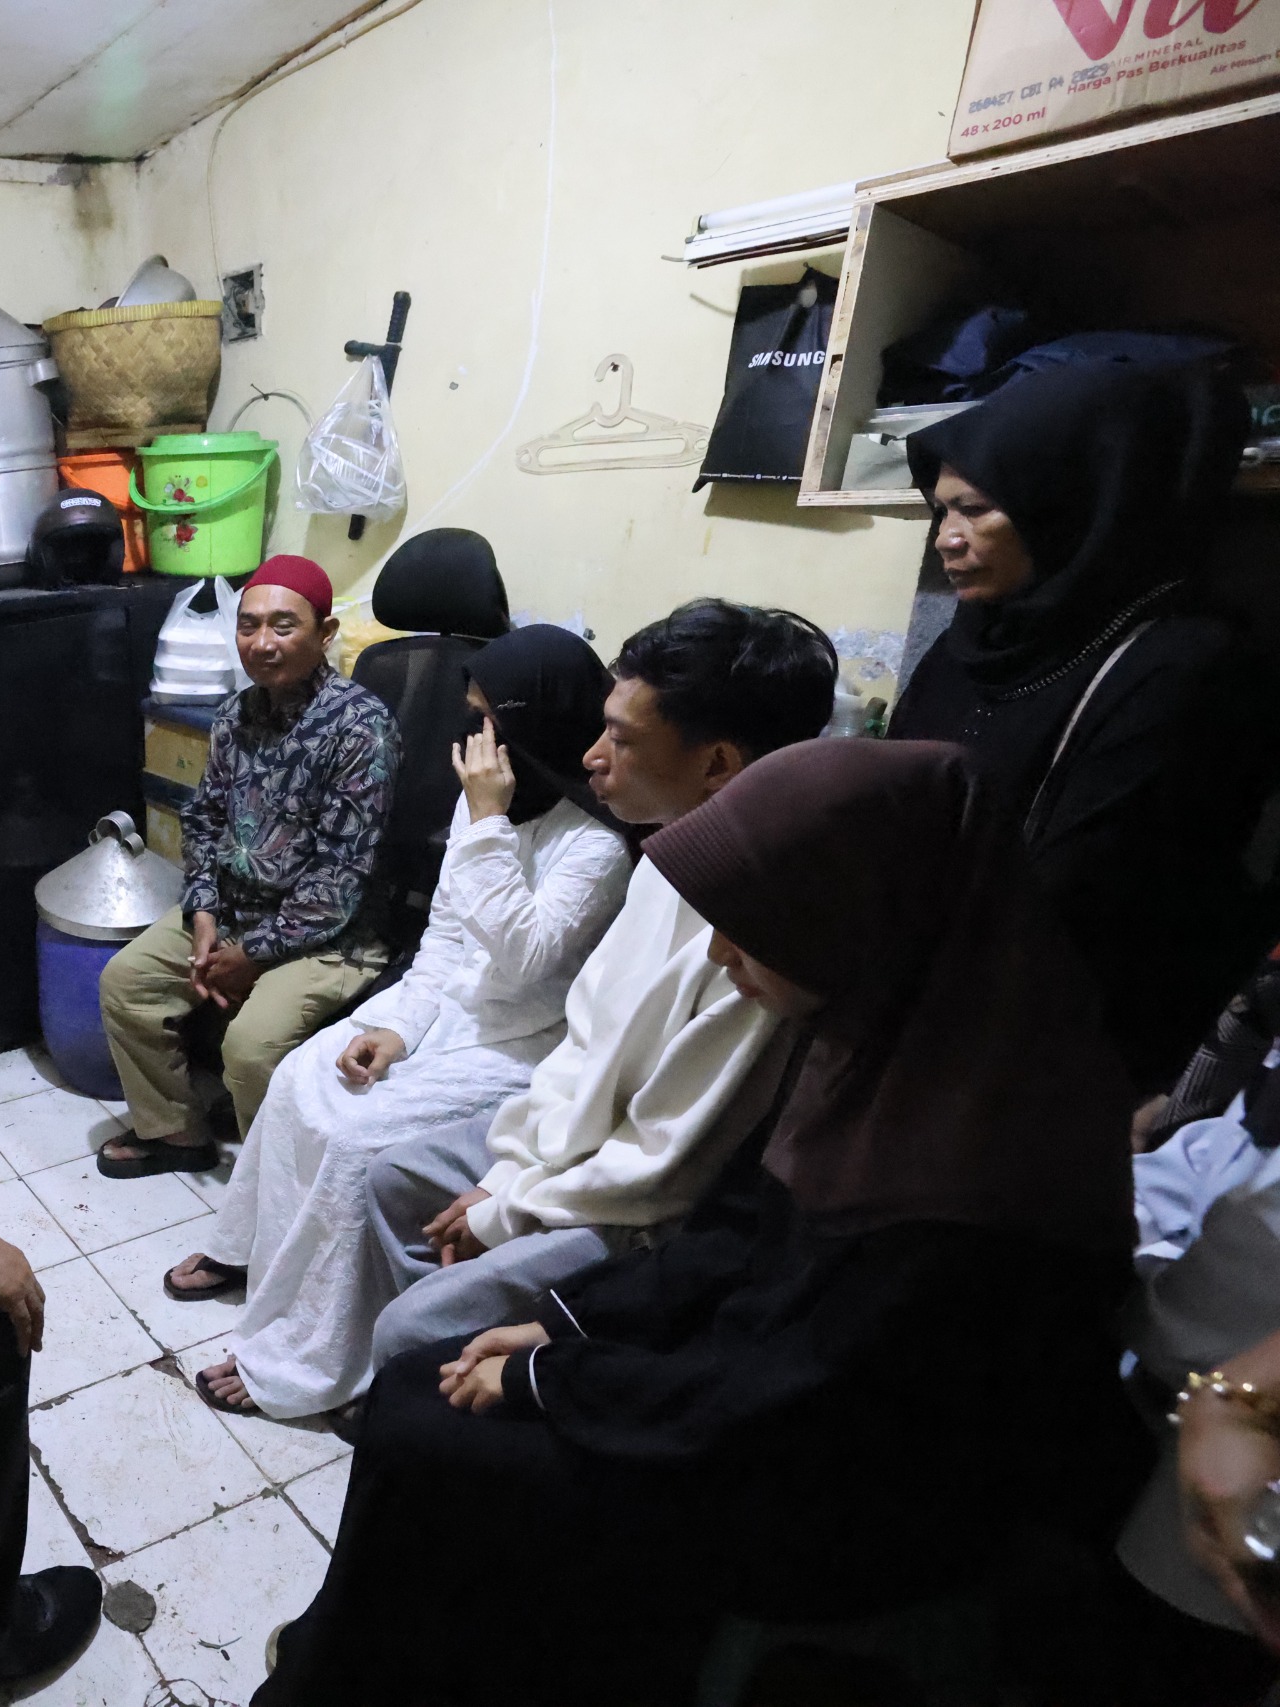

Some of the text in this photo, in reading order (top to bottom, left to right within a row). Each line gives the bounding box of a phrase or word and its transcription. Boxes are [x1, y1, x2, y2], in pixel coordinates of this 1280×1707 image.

[1134, 37, 1203, 63] MINERAL
[1067, 40, 1247, 95] Harga Pas Berkualitas
[960, 107, 1047, 138] 48 x 200 ml
[747, 350, 826, 369] SAMSUNG
